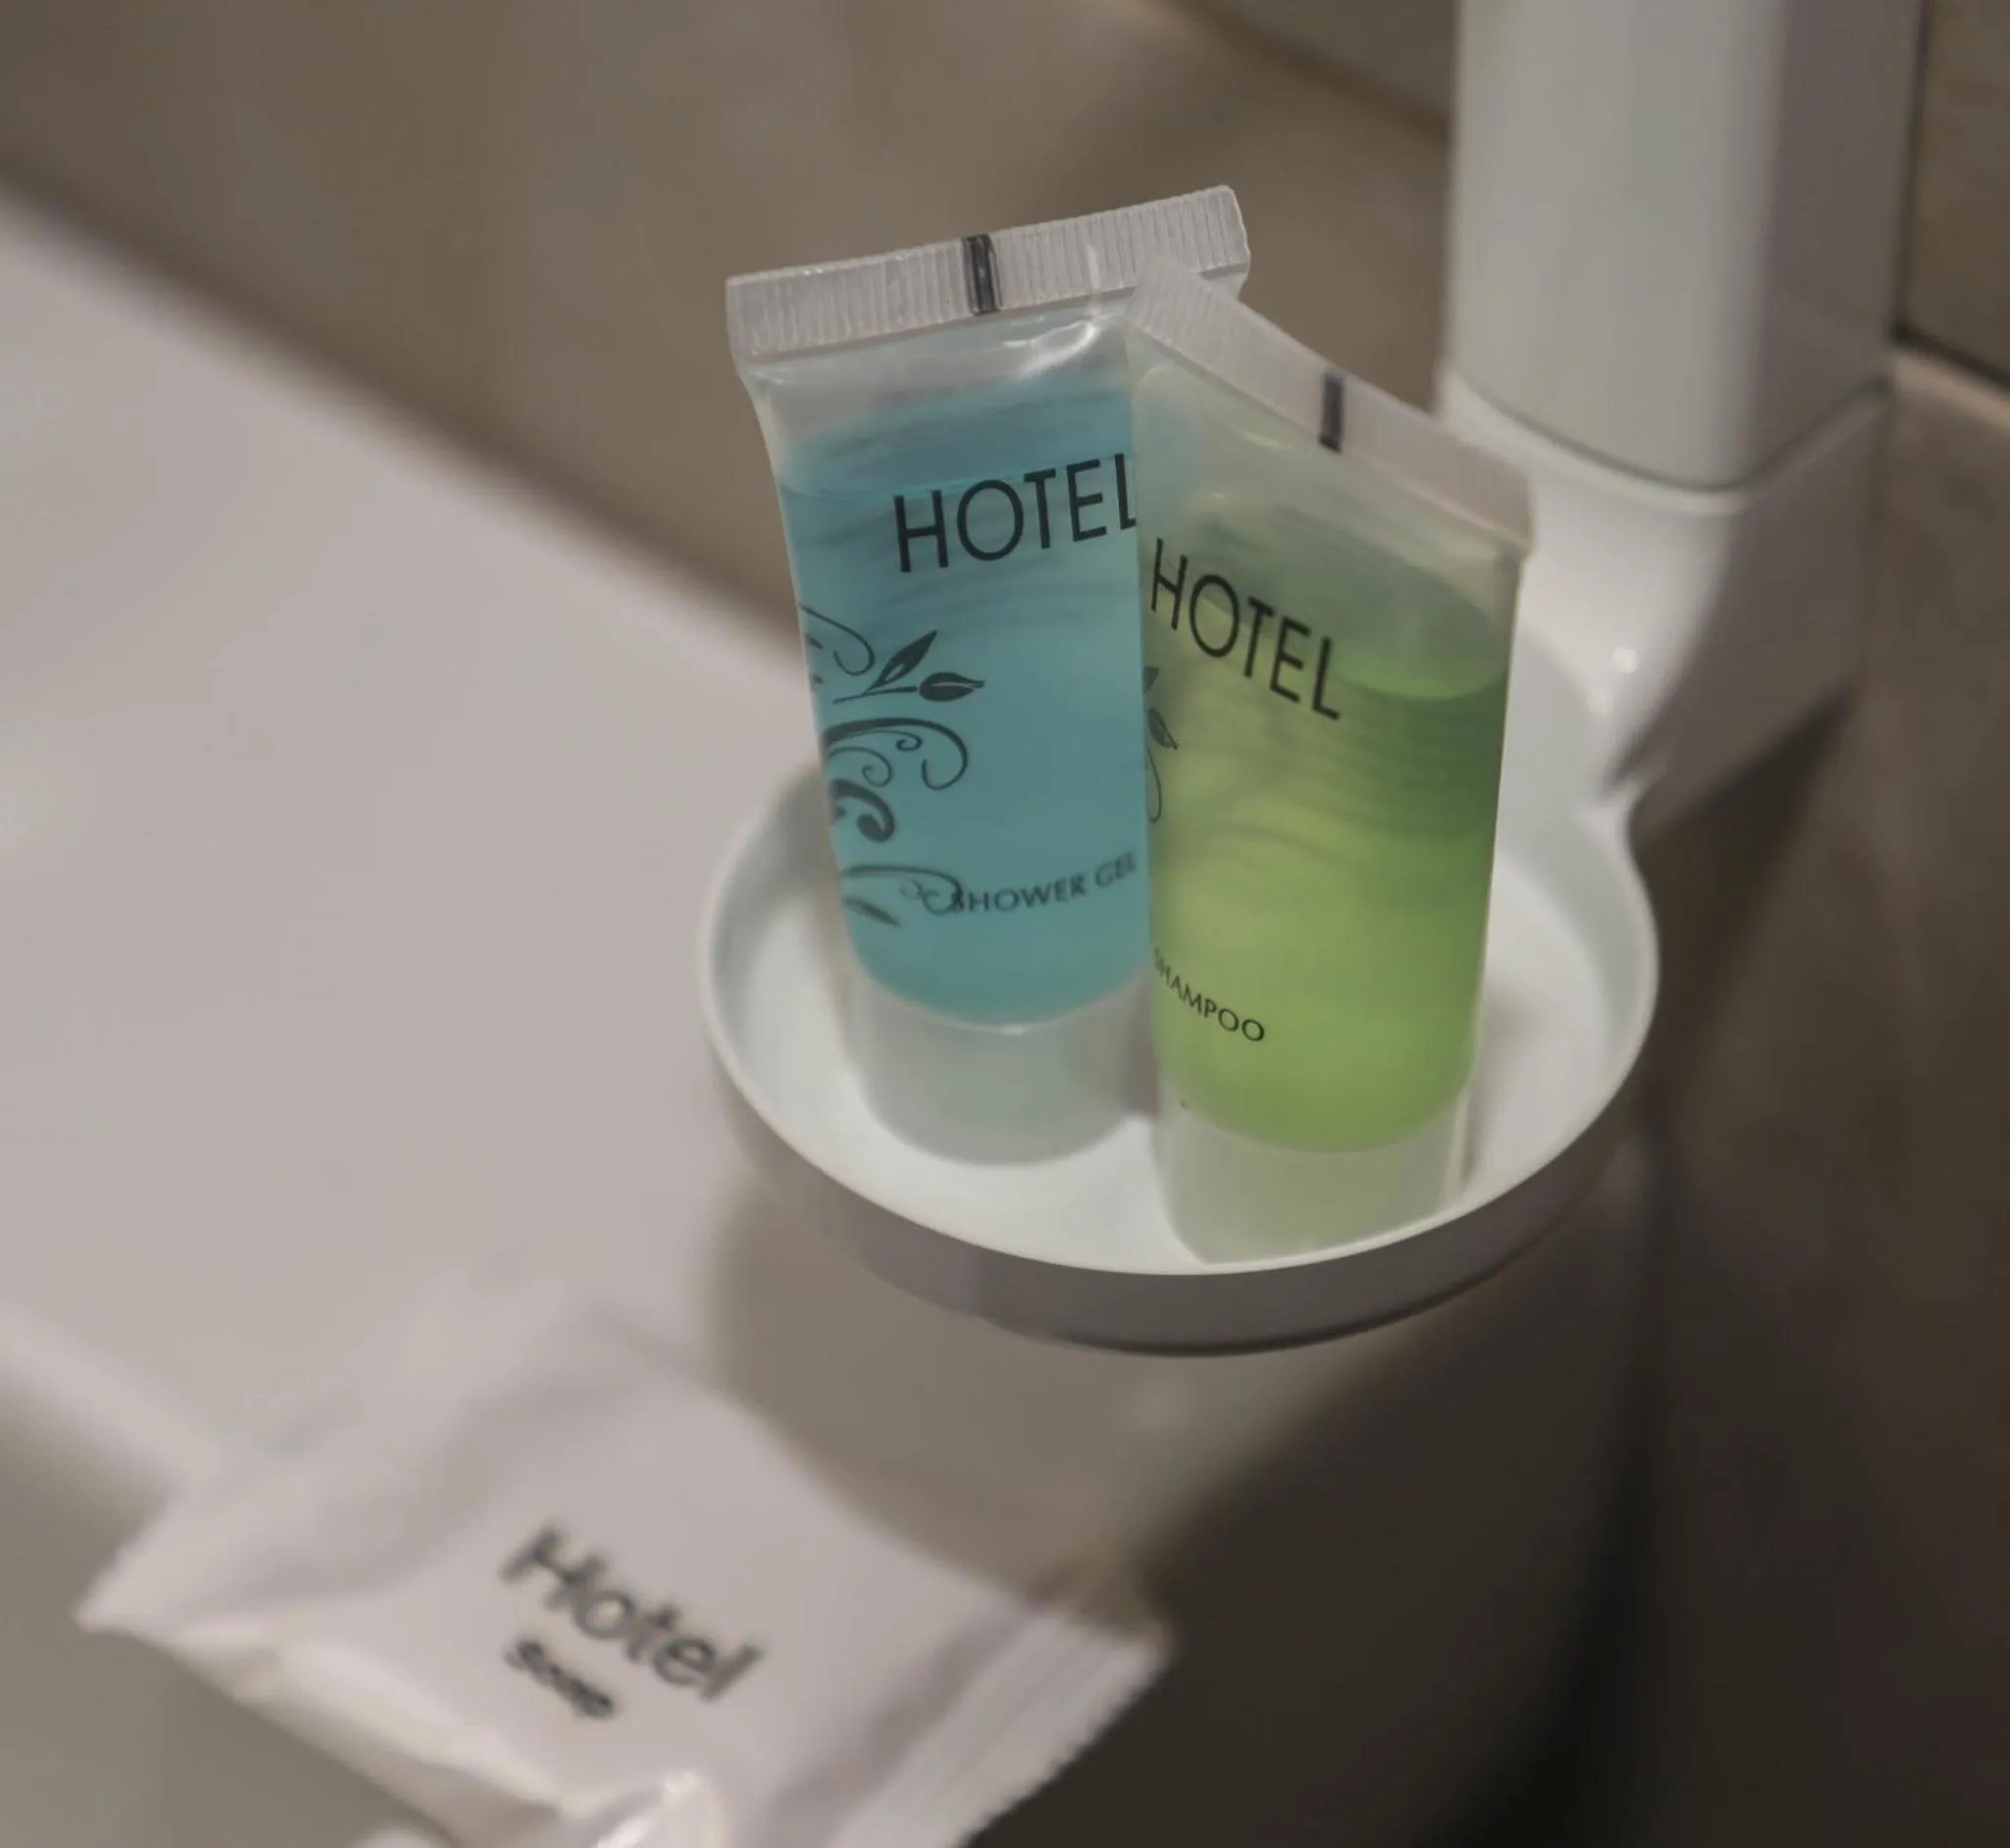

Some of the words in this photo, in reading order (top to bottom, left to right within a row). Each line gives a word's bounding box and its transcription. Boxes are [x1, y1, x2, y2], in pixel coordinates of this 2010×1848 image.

[894, 452, 1137, 573] HOTEL
[1150, 537, 1341, 720] HOTEL
[950, 872, 1086, 913] SHOWER
[1095, 850, 1137, 889] GEL
[1154, 947, 1265, 1042] SHAMPOO
[501, 1526, 763, 1704] Hotel
[504, 1640, 615, 1719] Soap
